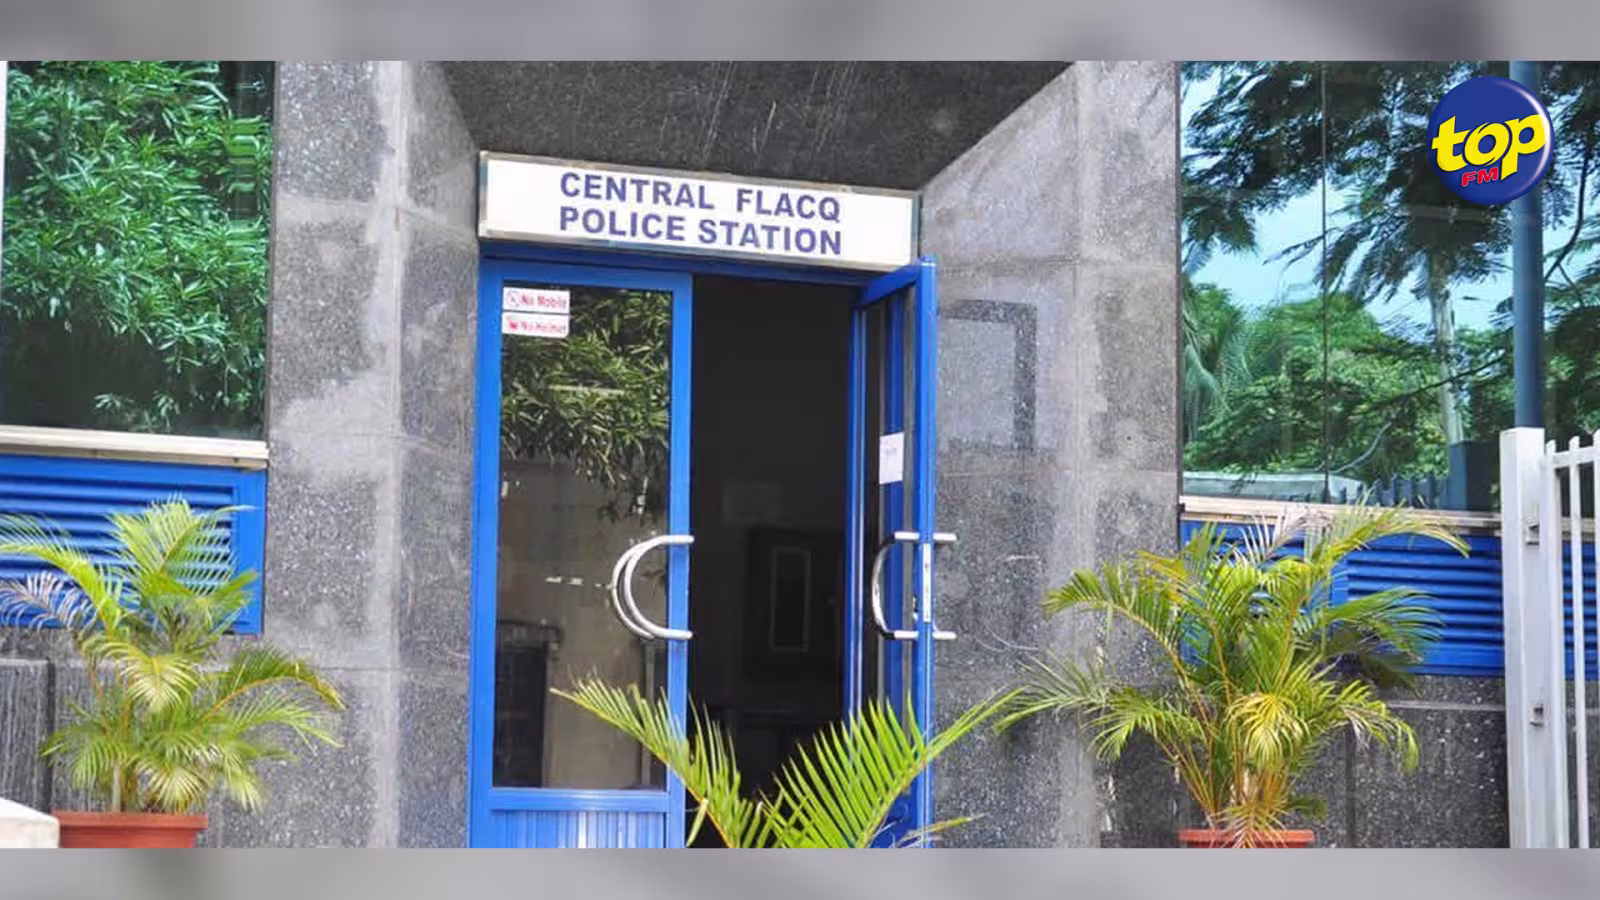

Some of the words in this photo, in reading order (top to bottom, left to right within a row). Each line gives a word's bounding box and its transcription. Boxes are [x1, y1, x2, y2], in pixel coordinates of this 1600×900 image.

[560, 172, 714, 210] CENTRAL
[736, 188, 841, 222] FLACQ
[559, 207, 686, 241] POLICE
[698, 219, 842, 255] STATION
